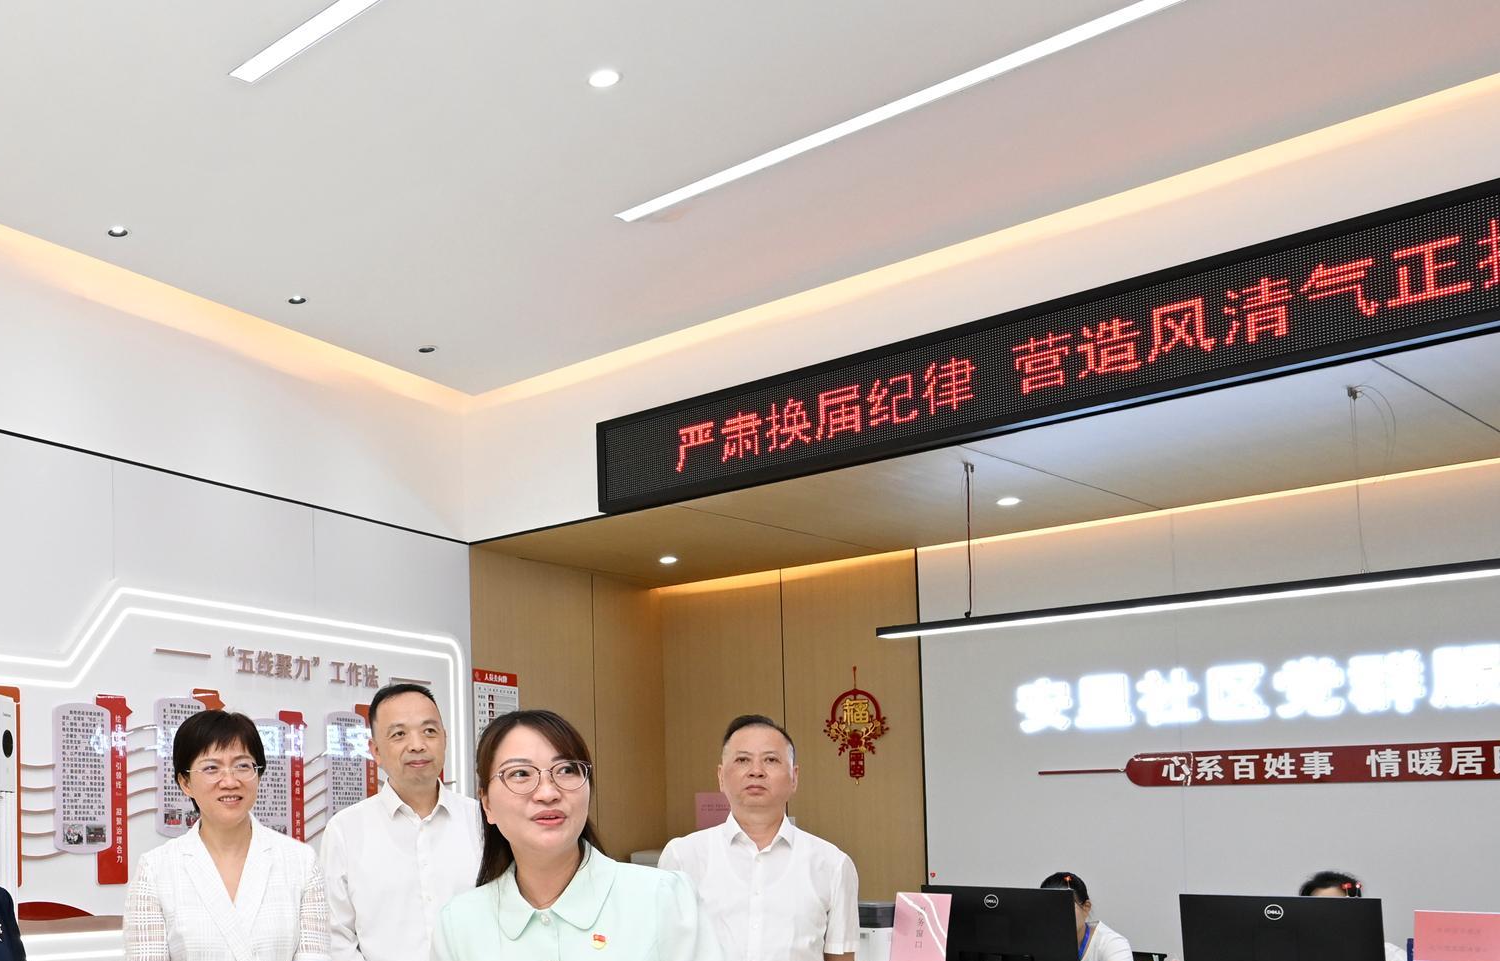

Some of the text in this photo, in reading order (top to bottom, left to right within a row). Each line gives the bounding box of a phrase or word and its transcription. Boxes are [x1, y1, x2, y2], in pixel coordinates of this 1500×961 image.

[675, 355, 978, 472] 严肃换届纪律
[329, 660, 380, 688] 工作法
[842, 698, 870, 726] 福
[1162, 745, 1500, 783] 心系百姓事 情暖居
